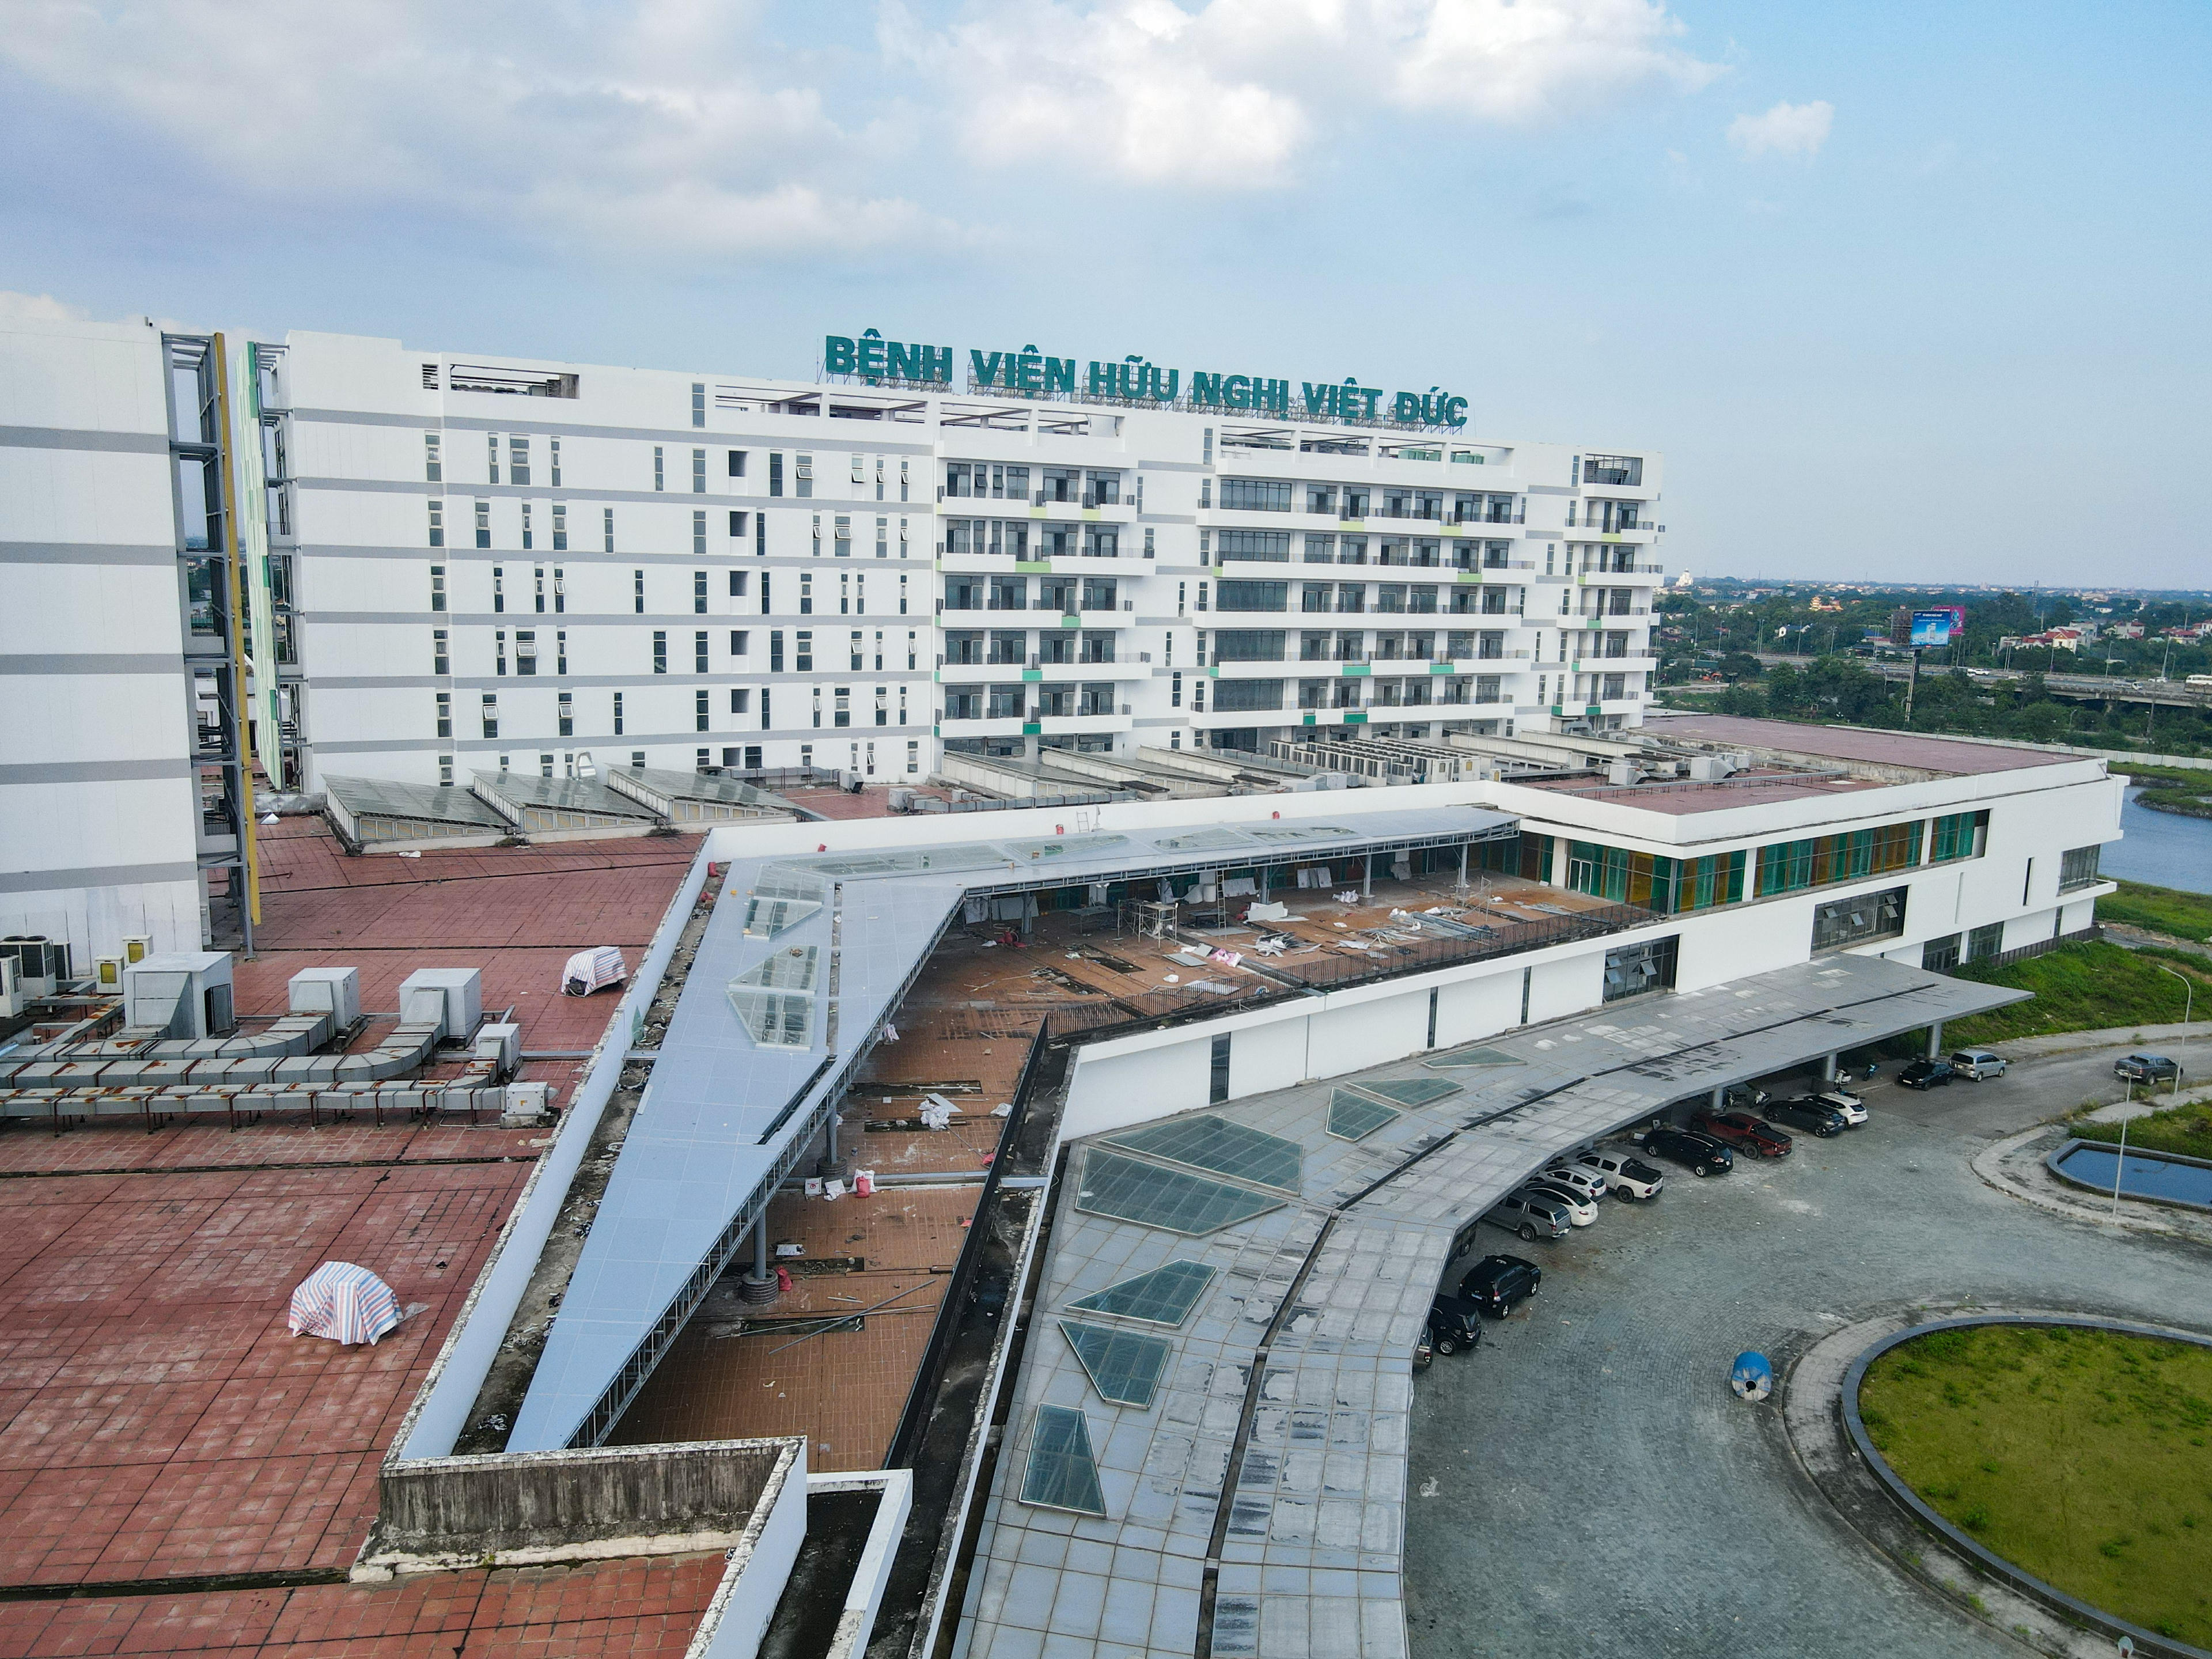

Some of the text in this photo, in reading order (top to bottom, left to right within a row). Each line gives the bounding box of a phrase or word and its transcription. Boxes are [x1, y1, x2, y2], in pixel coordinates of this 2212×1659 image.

[825, 328, 1468, 427] BỆNH VIỆN HỮU NGHỊ VIỆT ĐỨC
